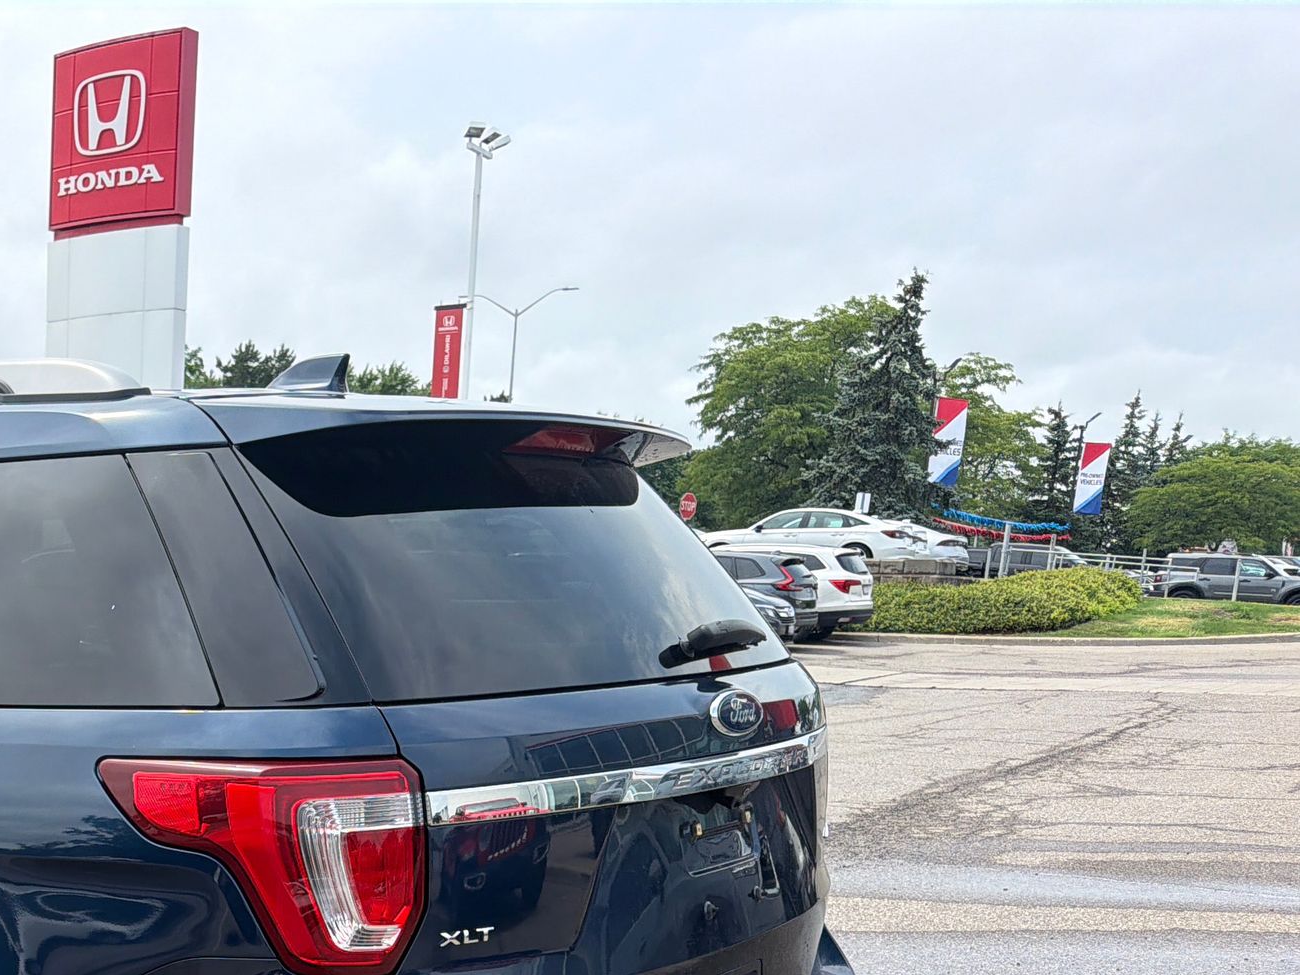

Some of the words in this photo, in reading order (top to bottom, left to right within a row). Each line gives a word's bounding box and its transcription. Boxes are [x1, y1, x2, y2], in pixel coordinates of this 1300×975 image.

[57, 164, 164, 197] HONDA
[681, 500, 696, 512] STOP
[730, 697, 757, 724] Ford
[671, 749, 805, 790] EXPLORER
[439, 926, 495, 948] XLT
